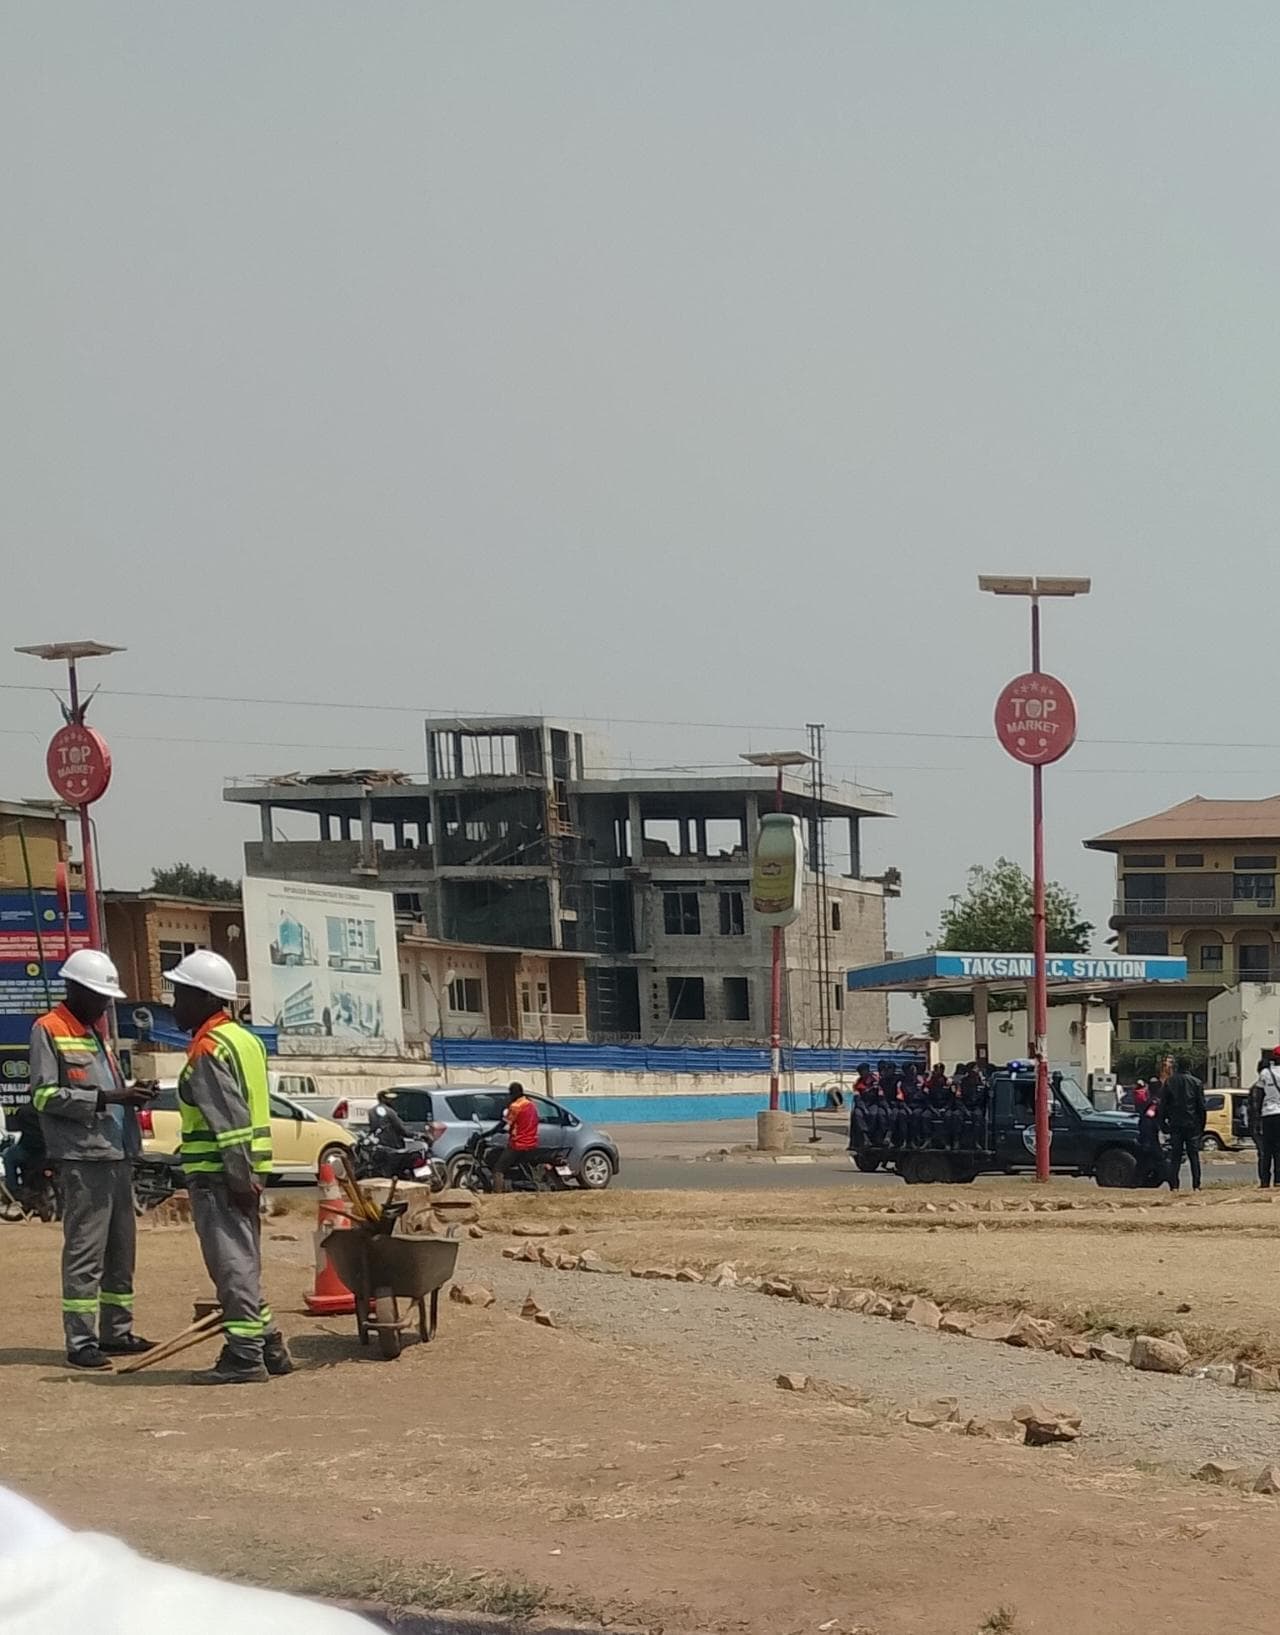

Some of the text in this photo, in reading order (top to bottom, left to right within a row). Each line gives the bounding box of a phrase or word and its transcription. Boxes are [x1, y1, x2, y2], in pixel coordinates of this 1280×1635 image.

[1010, 698, 1057, 719] TOP
[1006, 719, 1060, 735] MARKET
[57, 745, 92, 765] TOP
[57, 764, 96, 779] MARKET
[960, 958, 1033, 977] TAKSAN
[1072, 959, 1146, 978] STATION
